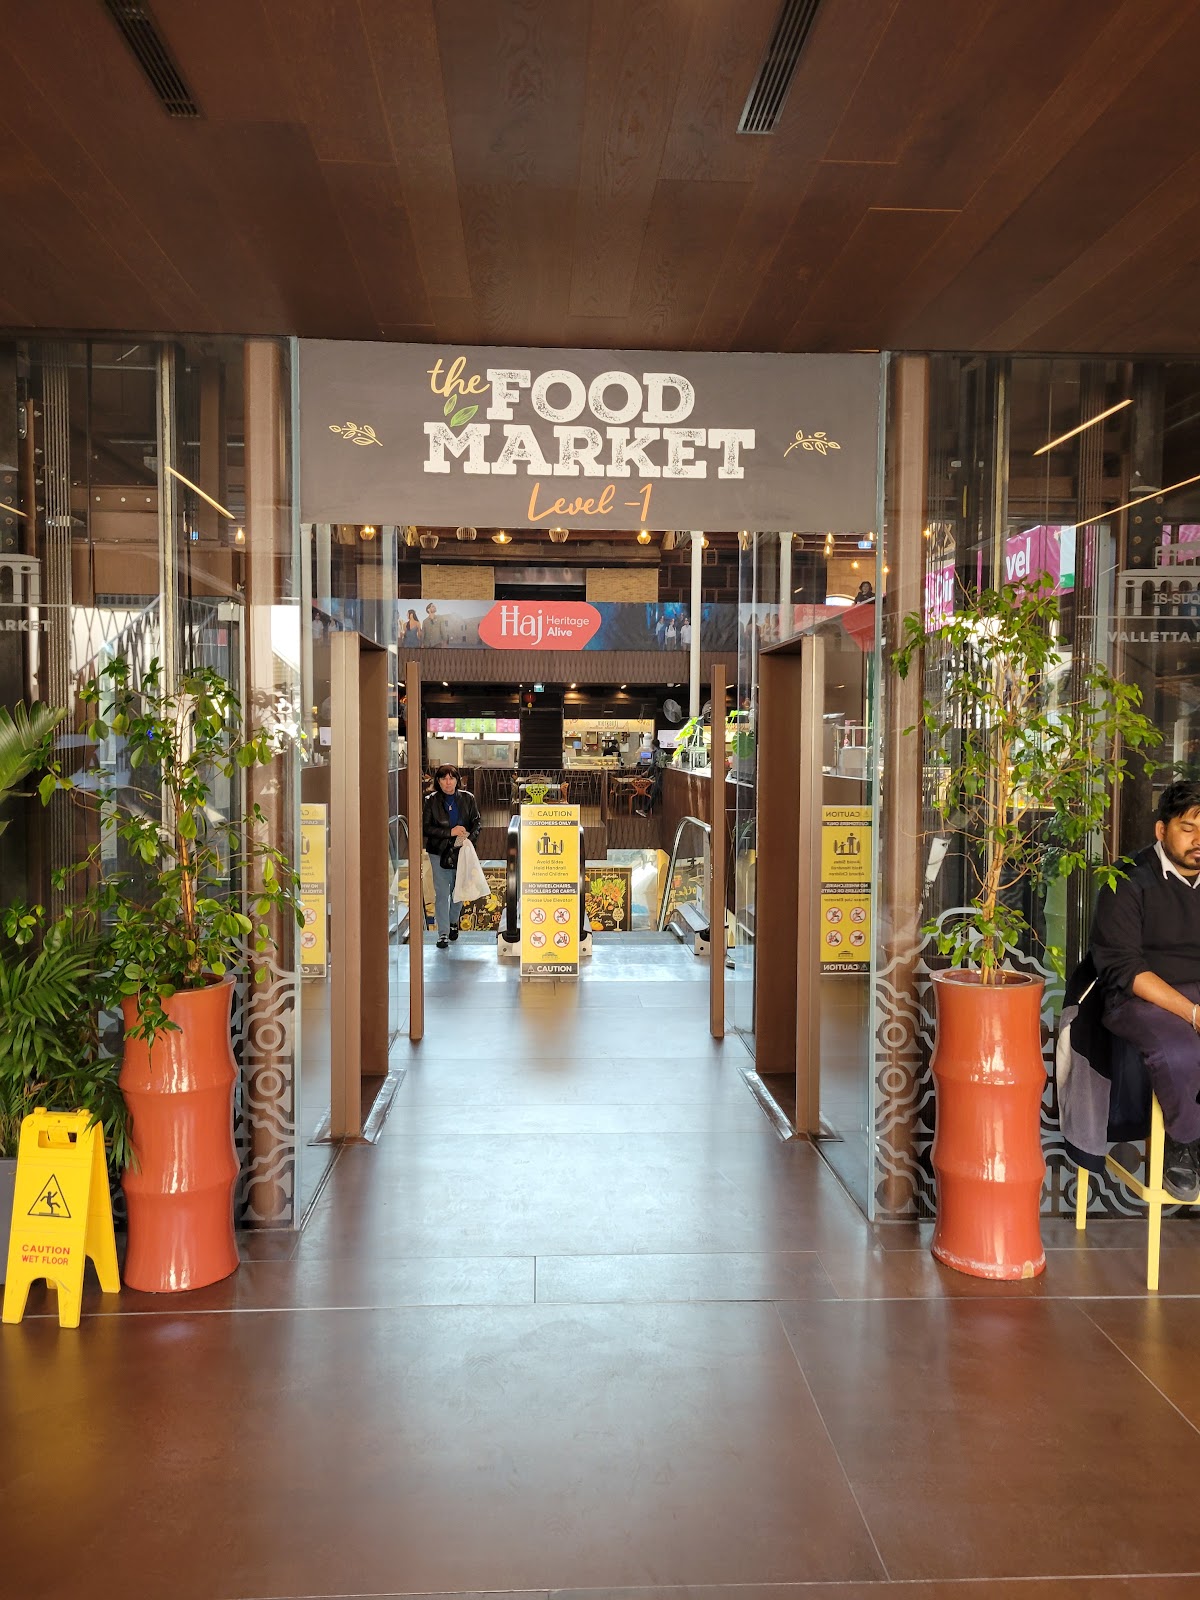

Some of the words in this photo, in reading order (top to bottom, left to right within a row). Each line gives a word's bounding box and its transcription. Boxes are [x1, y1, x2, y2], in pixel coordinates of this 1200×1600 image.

[426, 356, 491, 397] the
[486, 368, 695, 424] FOOD
[423, 422, 756, 479] MARKET
[527, 482, 616, 522] Level
[624, 483, 653, 522] -1
[546, 614, 590, 628] Heritage
[546, 626, 573, 637] Alive
[1107, 631, 1191, 643] VALLETTA
[22, 1244, 70, 1255] CAUTION
[22, 1255, 39, 1263] WET
[42, 1256, 69, 1265] FLOOR
